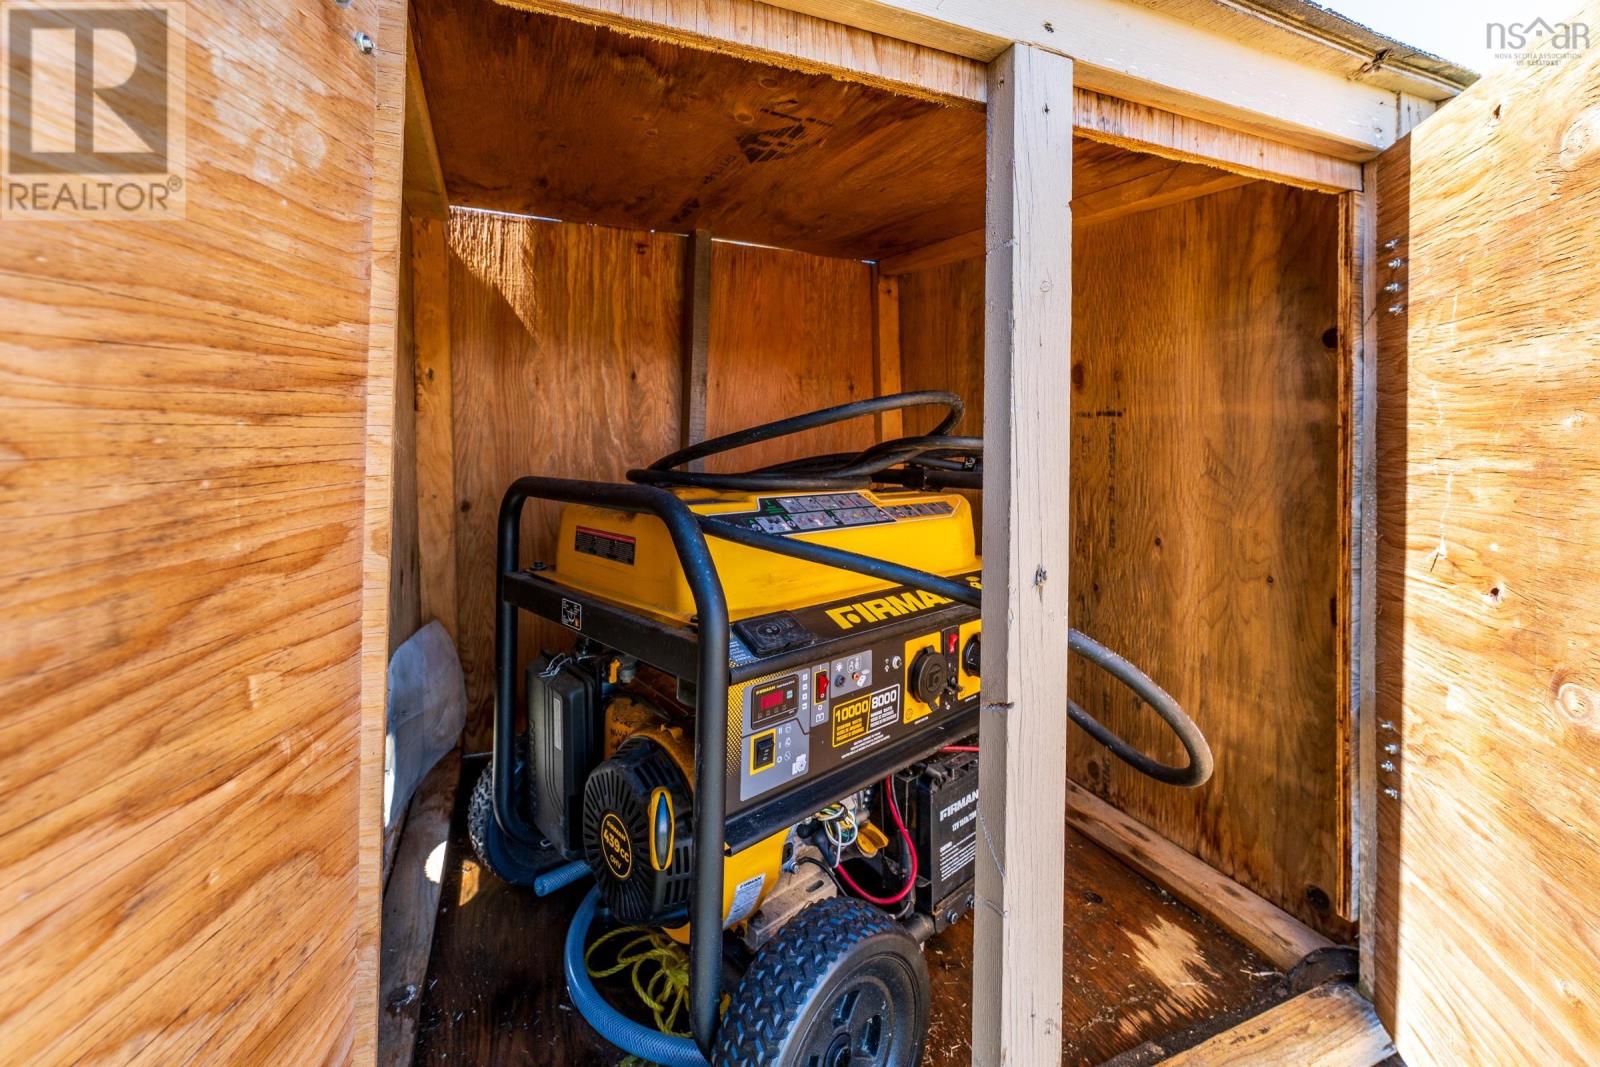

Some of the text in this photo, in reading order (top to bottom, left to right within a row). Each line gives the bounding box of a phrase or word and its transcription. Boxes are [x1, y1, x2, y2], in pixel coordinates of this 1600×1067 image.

[825, 589, 954, 630] FIRMA
[836, 699, 869, 723] 10000
[871, 689, 897, 709] 8000
[940, 789, 979, 821] FIRMAN
